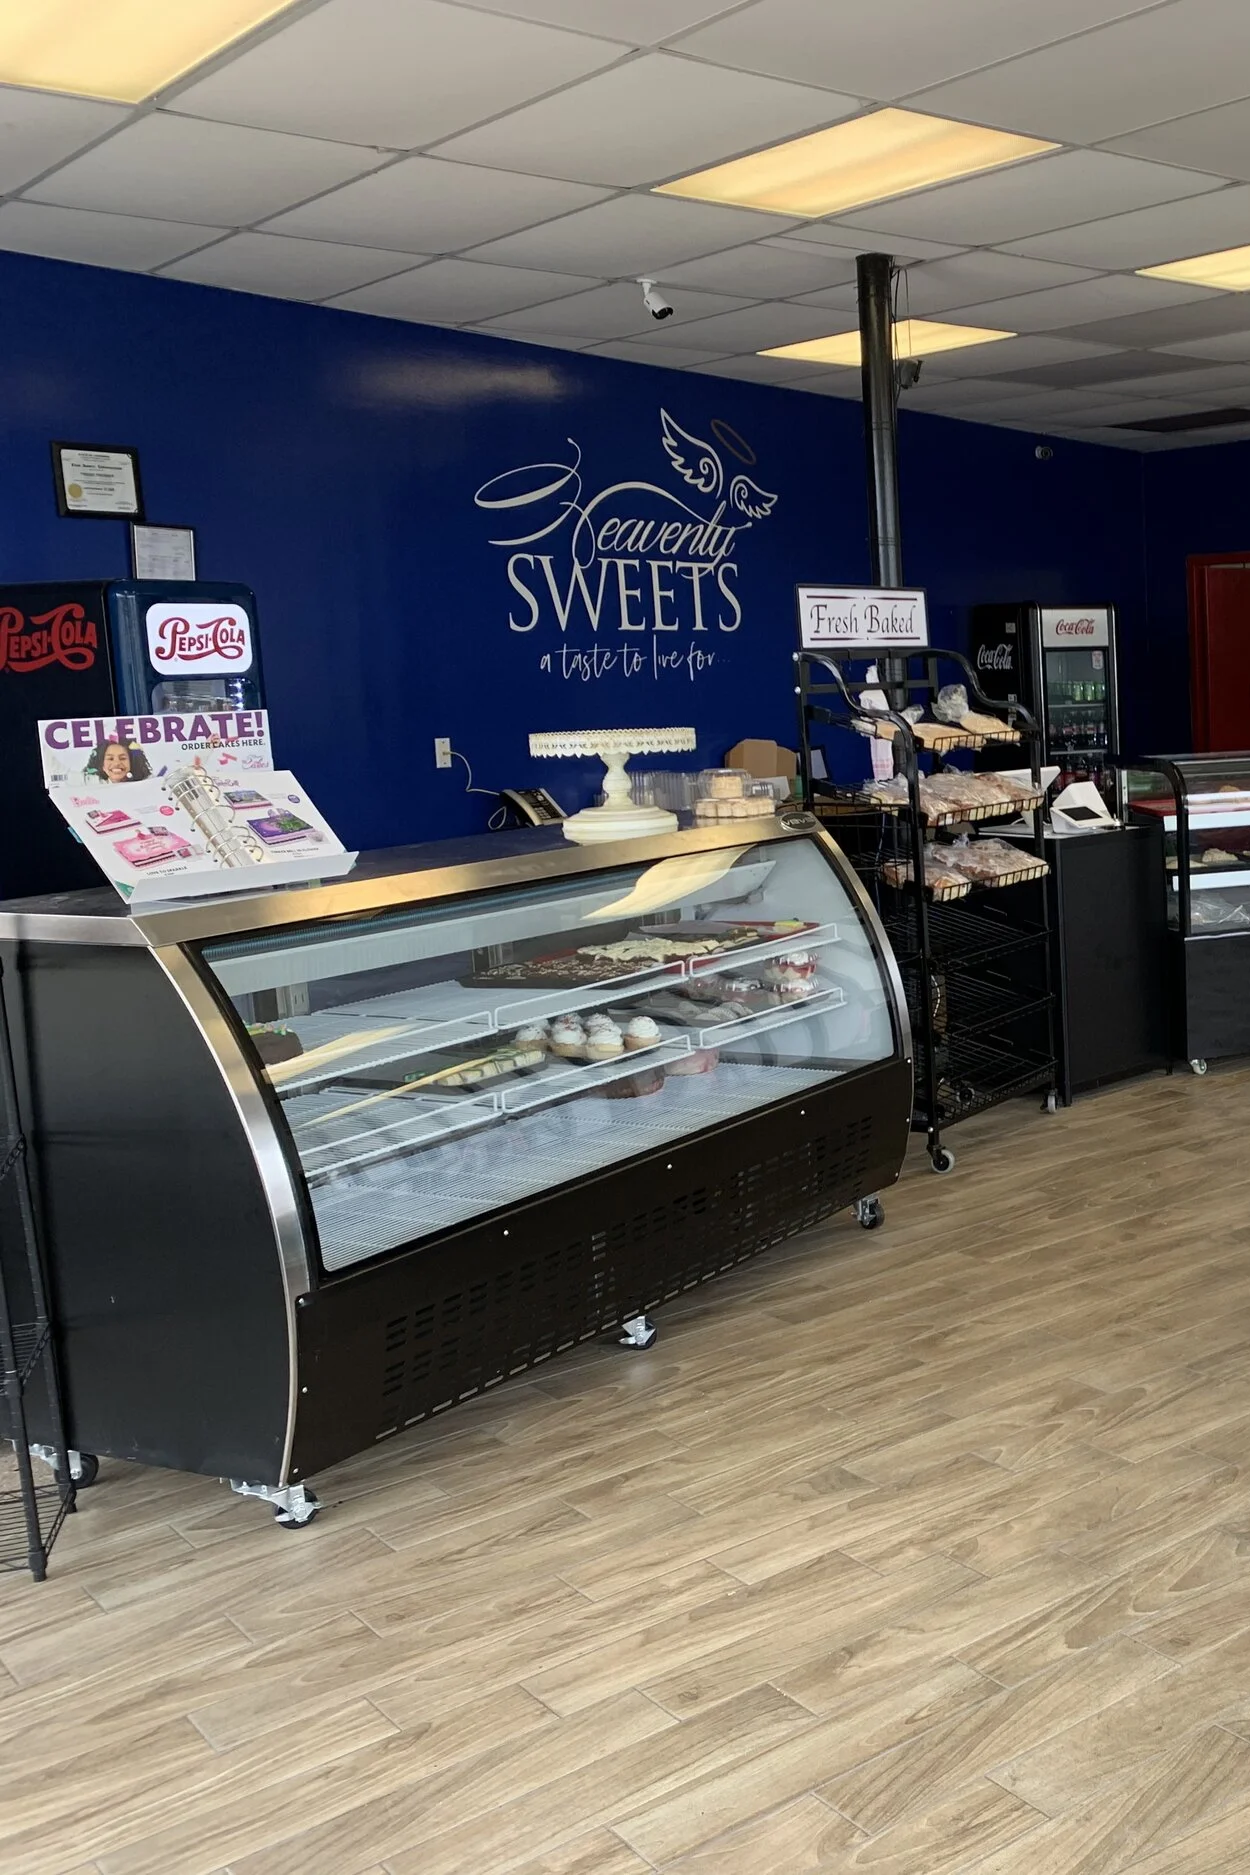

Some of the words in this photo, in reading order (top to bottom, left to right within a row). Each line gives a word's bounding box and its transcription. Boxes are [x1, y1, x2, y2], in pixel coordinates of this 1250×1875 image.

[474, 437, 752, 580] Heavenly
[507, 553, 742, 632] SWEETS
[810, 603, 858, 635] Fresh
[864, 603, 914, 635] Baked
[1055, 617, 1095, 636] Coca-Cola
[540, 653, 551, 673] a
[555, 642, 620, 681] taste
[616, 645, 647, 680] to
[653, 634, 684, 681] live
[977, 642, 1013, 671] Coca-Cola
[45, 710, 265, 750] CELEBRATE!
[181, 741, 211, 751] ORDER
[211, 739, 241, 750] CAKES
